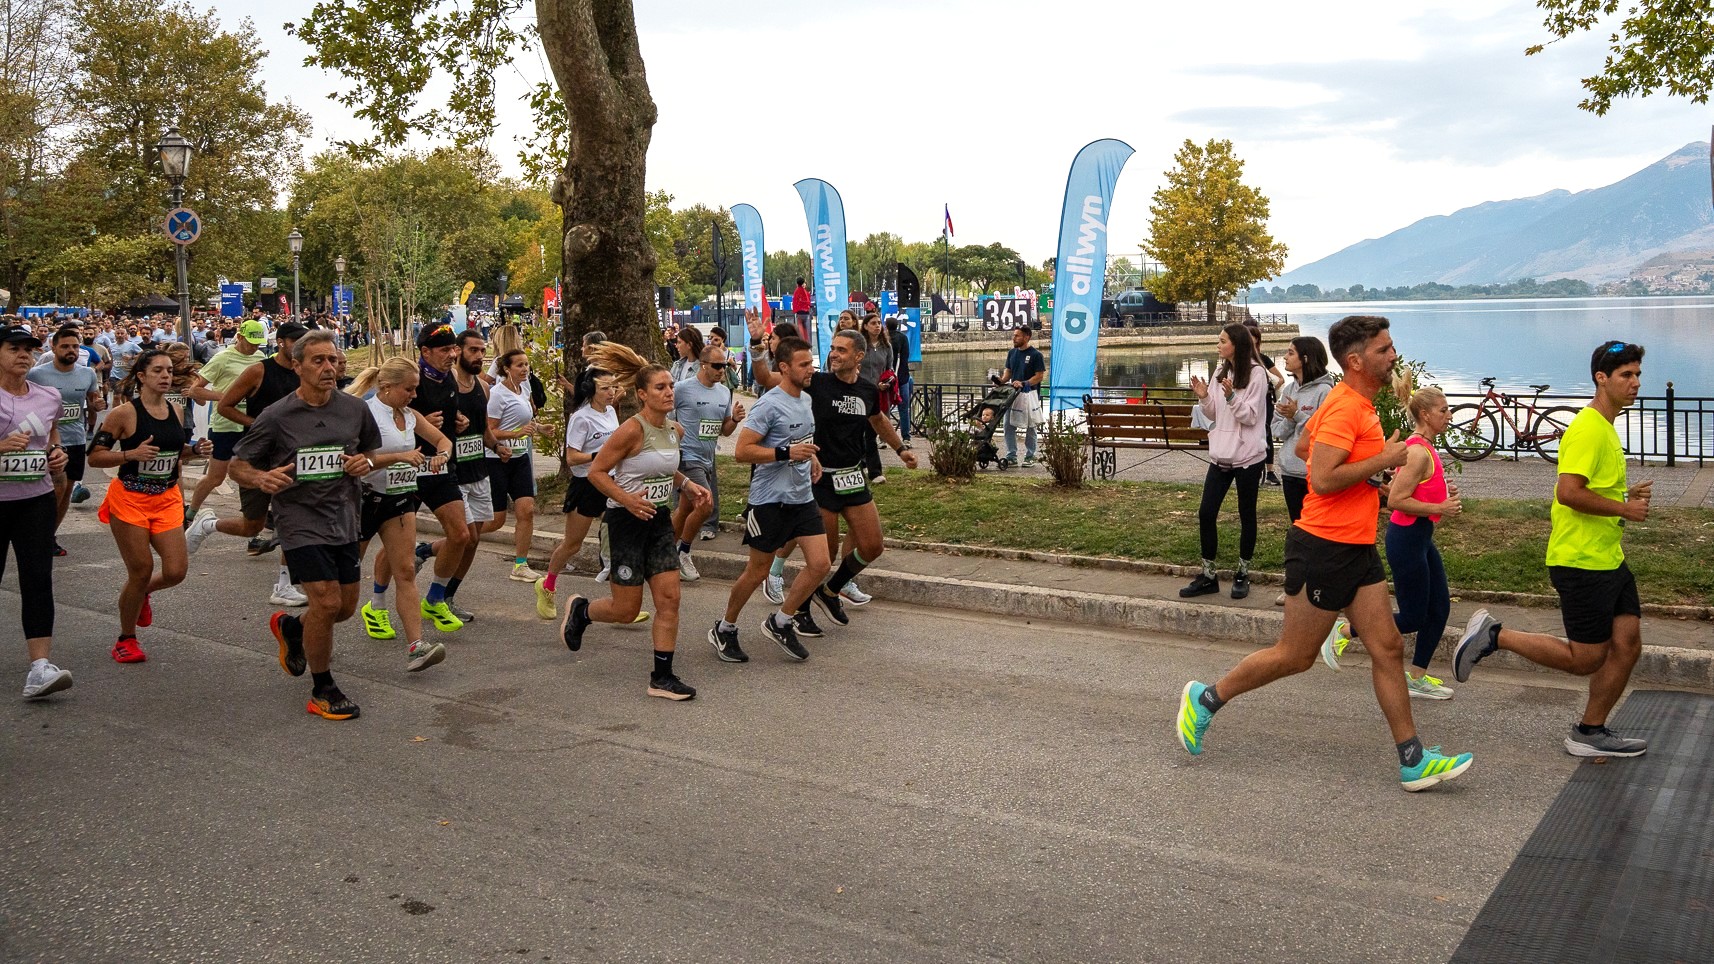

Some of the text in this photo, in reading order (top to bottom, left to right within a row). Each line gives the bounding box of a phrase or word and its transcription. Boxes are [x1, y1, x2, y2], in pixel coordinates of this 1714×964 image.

[1066, 195, 1106, 295] allwyn
[985, 300, 1028, 331] 365
[832, 400, 856, 409] NORTH
[838, 407, 856, 415] FACE
[457, 440, 482, 454] 12588
[3, 457, 46, 472] 12142
[300, 453, 343, 470] 12144
[388, 469, 417, 485] 12432
[835, 474, 863, 488] 11426
